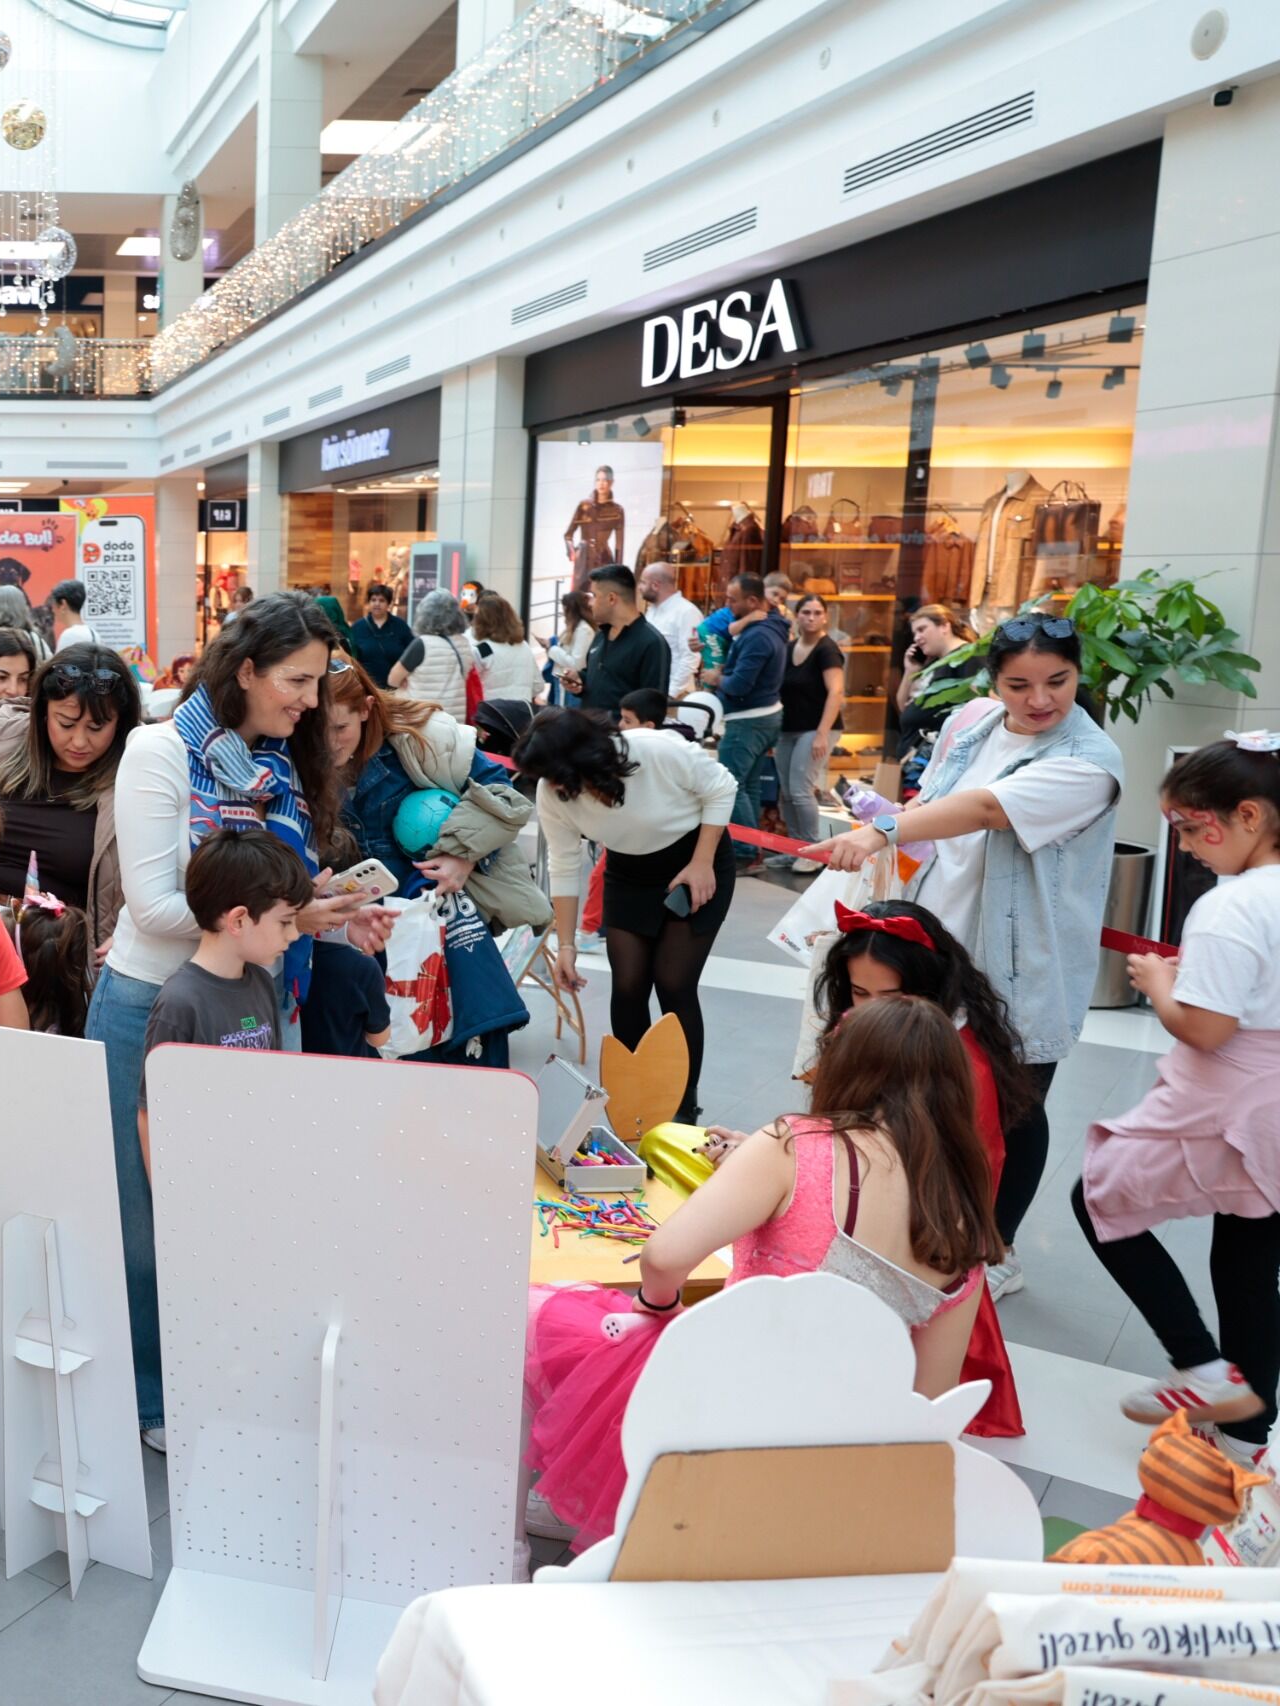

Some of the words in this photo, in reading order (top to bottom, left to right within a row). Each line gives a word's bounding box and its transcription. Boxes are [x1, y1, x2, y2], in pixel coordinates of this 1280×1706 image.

[641, 278, 800, 387] DESA
[24, 529, 53, 546] Bul!
[103, 541, 134, 551] dodo
[103, 553, 136, 565] pizza
